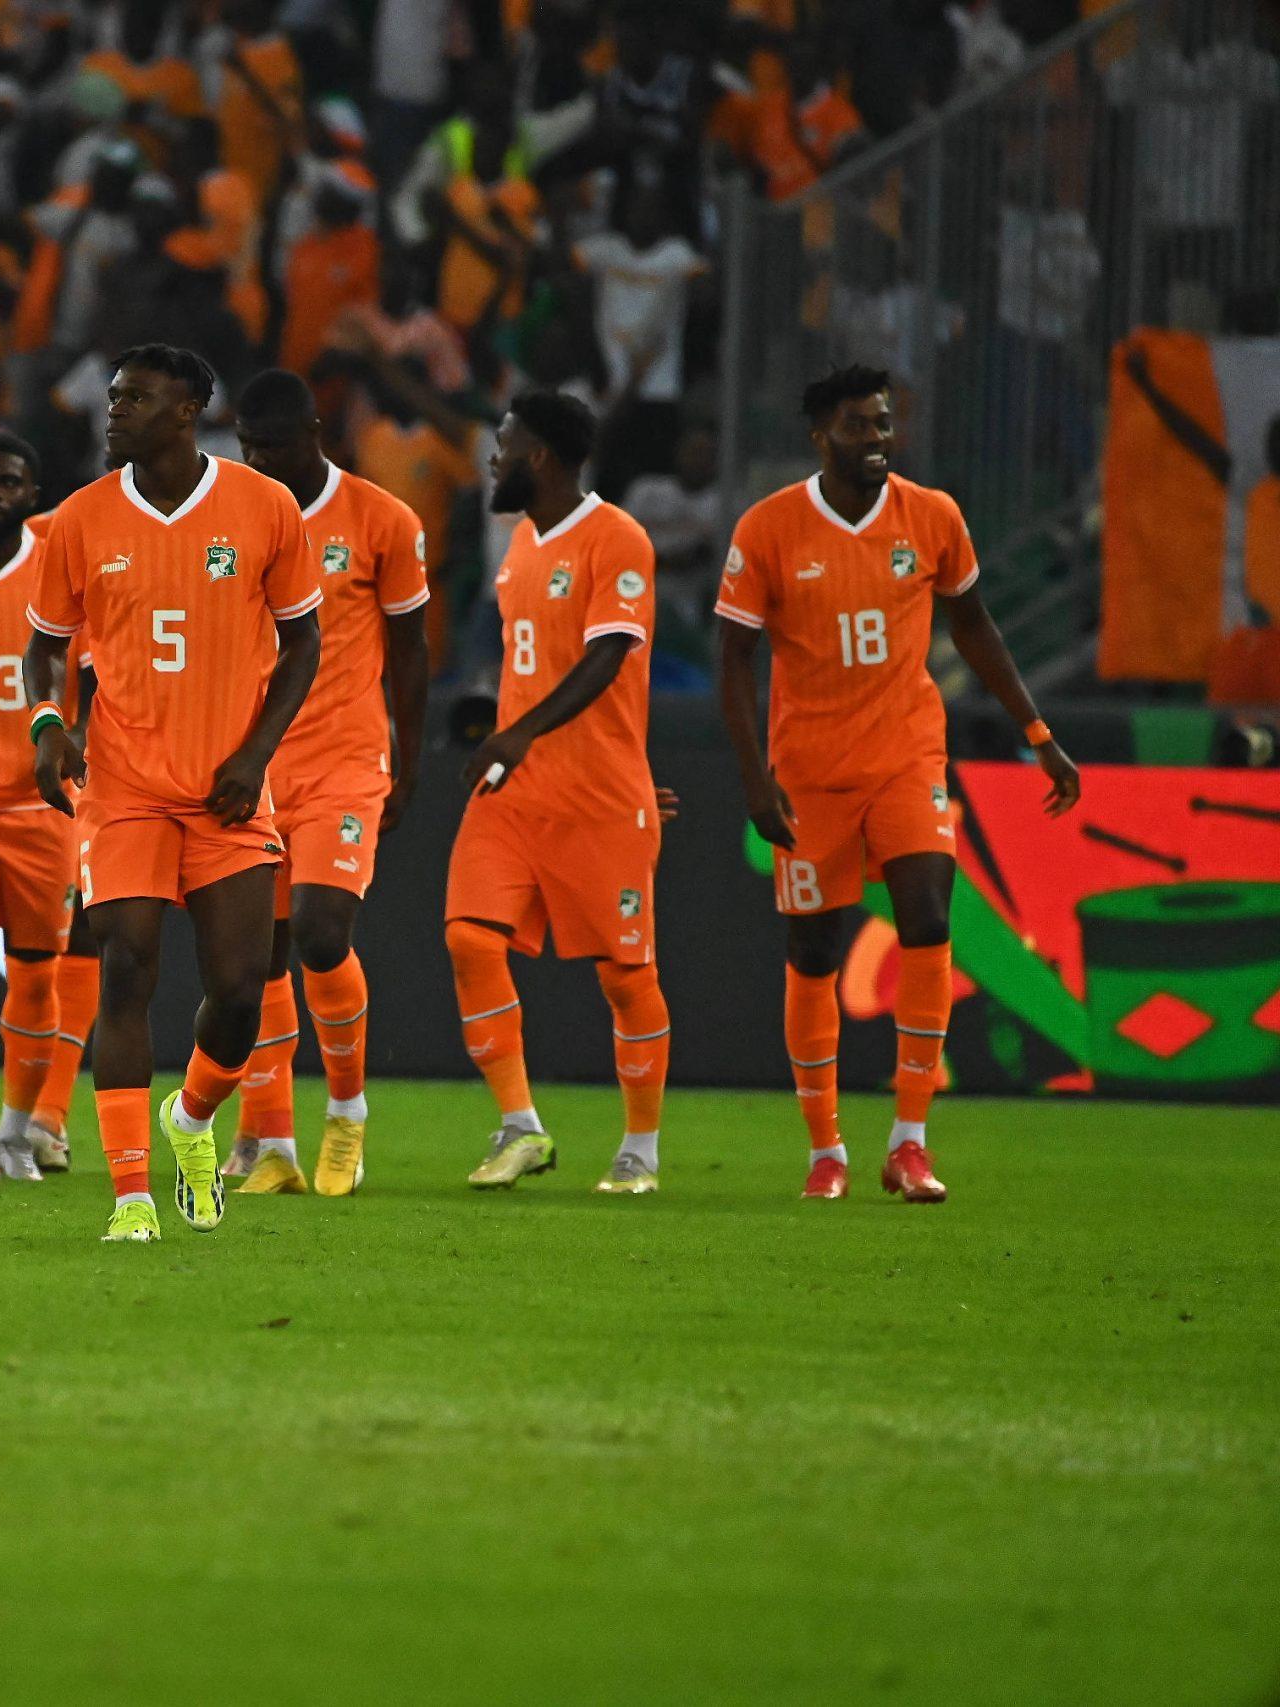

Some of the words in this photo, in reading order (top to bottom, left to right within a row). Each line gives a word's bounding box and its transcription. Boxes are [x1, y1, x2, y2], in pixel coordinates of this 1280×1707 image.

[152, 610, 185, 672] 5
[513, 619, 536, 675] 8
[838, 609, 888, 667] 18
[781, 857, 823, 910] 18
